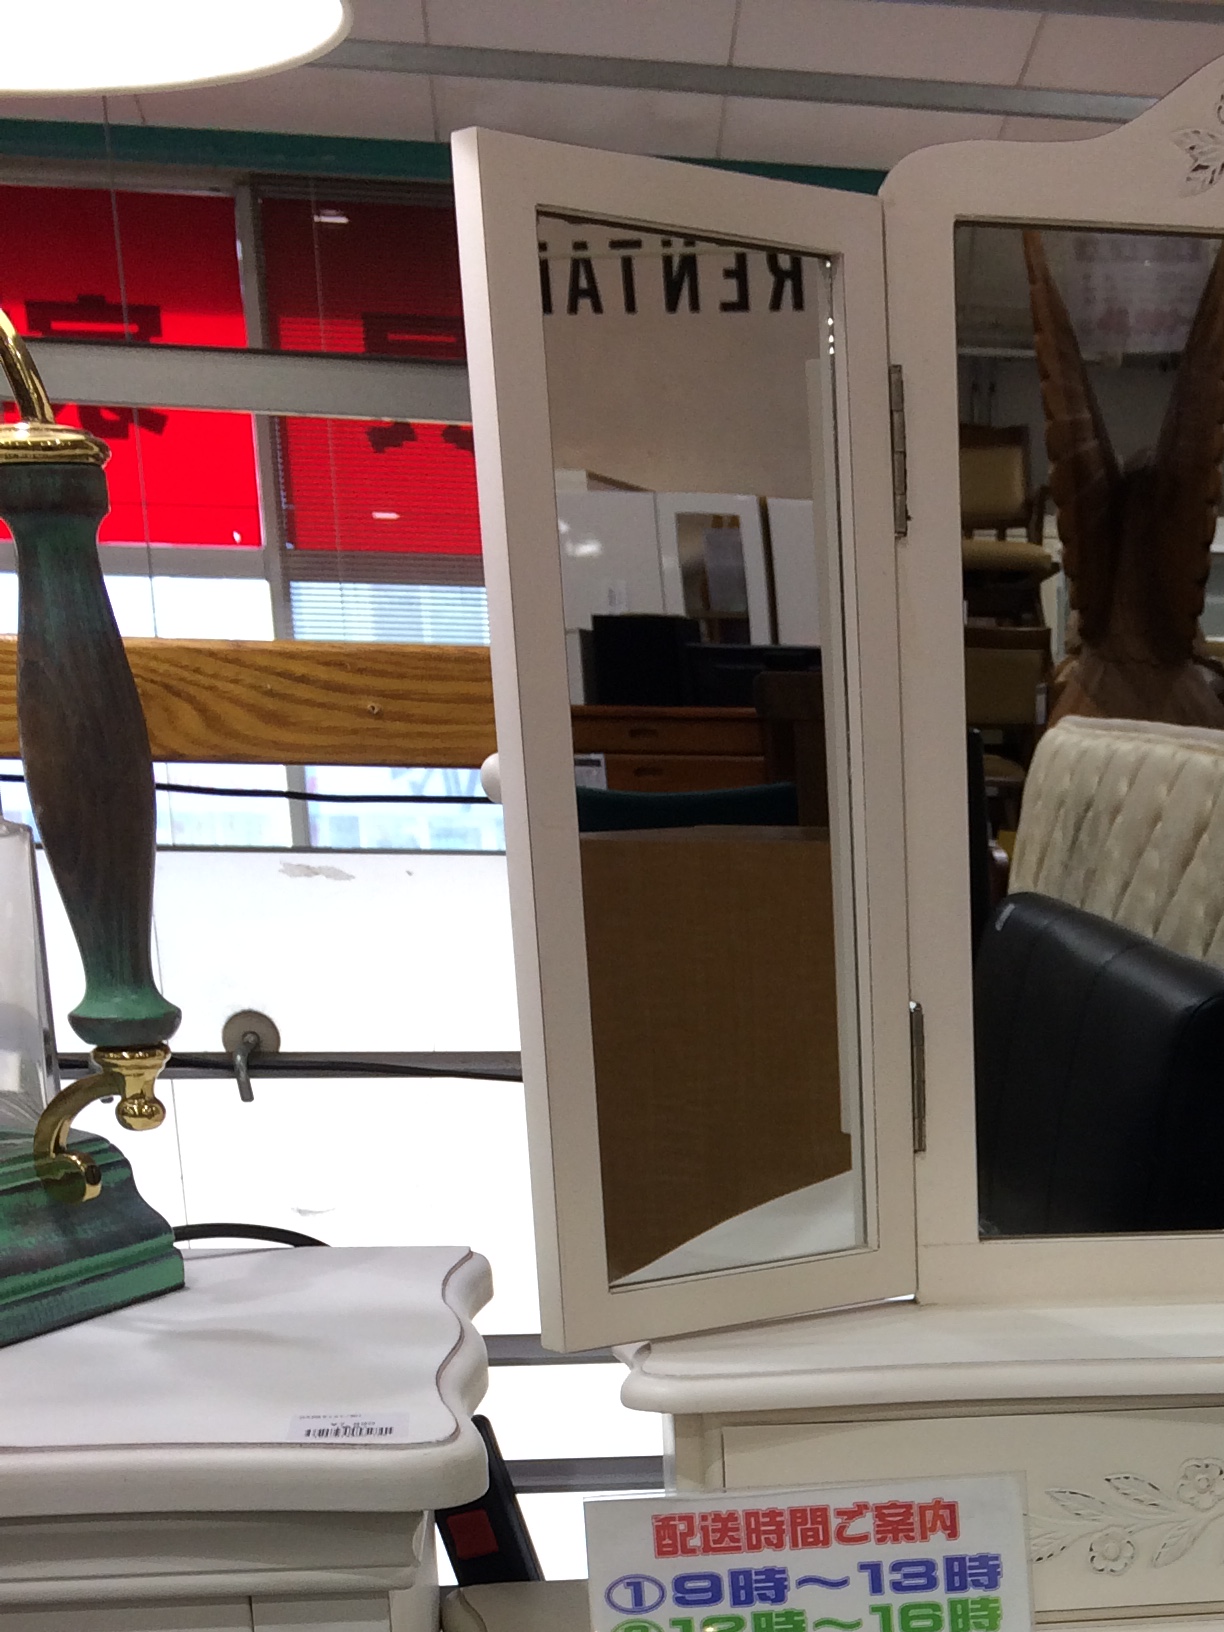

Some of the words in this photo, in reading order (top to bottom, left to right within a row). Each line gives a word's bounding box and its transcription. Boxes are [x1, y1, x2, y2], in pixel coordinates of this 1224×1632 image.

[652, 1498, 961, 1559] 配送時間ご案内
